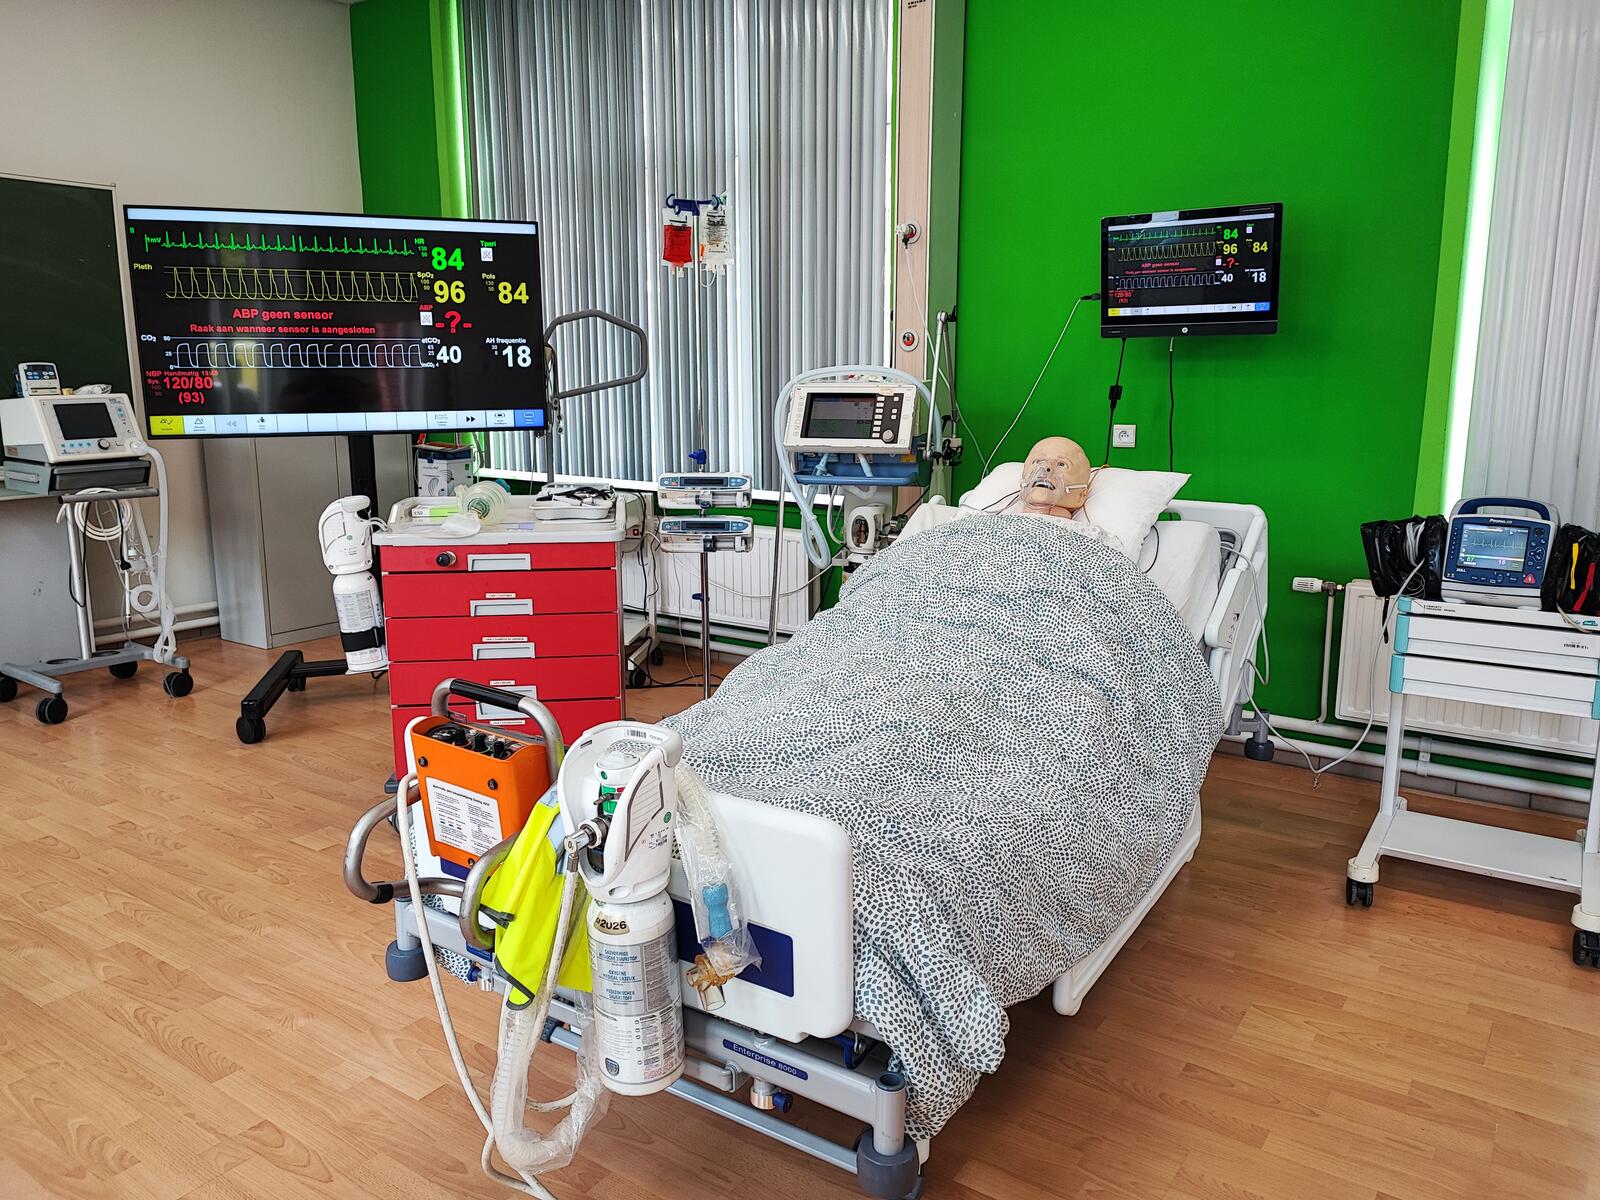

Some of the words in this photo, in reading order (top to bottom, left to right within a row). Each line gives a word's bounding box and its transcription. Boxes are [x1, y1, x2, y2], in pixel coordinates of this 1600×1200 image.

[1223, 228, 1239, 240] 84
[1222, 243, 1238, 255] 96
[1252, 241, 1268, 253] 84
[431, 246, 464, 271] 84
[1221, 273, 1234, 282] 40
[1252, 272, 1267, 283] 18
[433, 280, 466, 304] 96
[498, 281, 529, 304] 84
[232, 308, 259, 318] ABP
[262, 311, 291, 321] geen
[294, 311, 334, 320] sensor
[190, 324, 215, 332] Raak
[311, 325, 320, 333] is
[322, 326, 376, 336] aangesloten
[436, 345, 462, 364] 40
[502, 345, 532, 368] 18
[164, 370, 199, 378] Handmatig
[163, 376, 214, 389] 120/80
[178, 391, 205, 405] (93)
[733, 1043, 776, 1066] Enterprise
[778, 1063, 797, 1075] 8000
